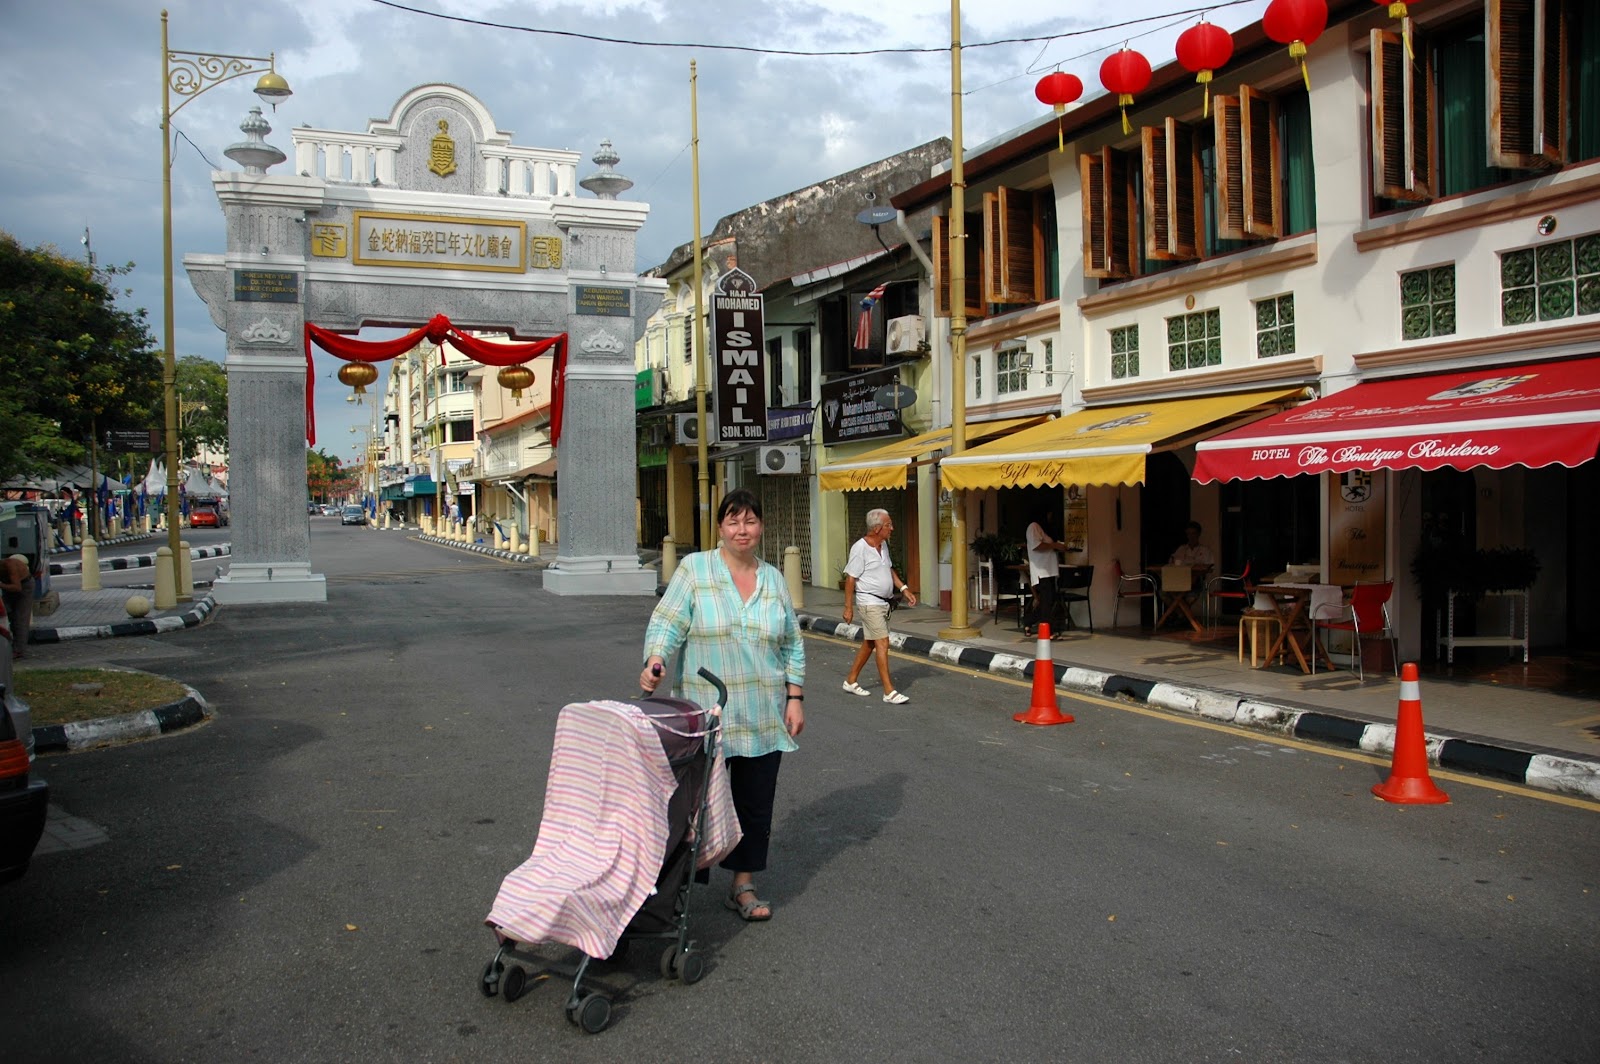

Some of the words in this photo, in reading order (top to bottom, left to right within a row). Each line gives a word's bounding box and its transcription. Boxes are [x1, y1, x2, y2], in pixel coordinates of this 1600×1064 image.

[729, 290, 747, 298] HAJI
[717, 297, 760, 310] MOHAMED
[722, 312, 758, 423] ISMAIL
[842, 399, 864, 416] Mohamed
[721, 426, 743, 438] SDN.
[744, 426, 765, 438] BHD.
[1251, 448, 1291, 461] HOTEL
[1298, 445, 1330, 467] The
[1331, 445, 1404, 467] Boutique
[1407, 438, 1501, 459] Residence
[847, 468, 873, 487] Caffe
[1000, 462, 1031, 485] Gift
[1037, 460, 1065, 484] shop
[1344, 526, 1367, 541] The
